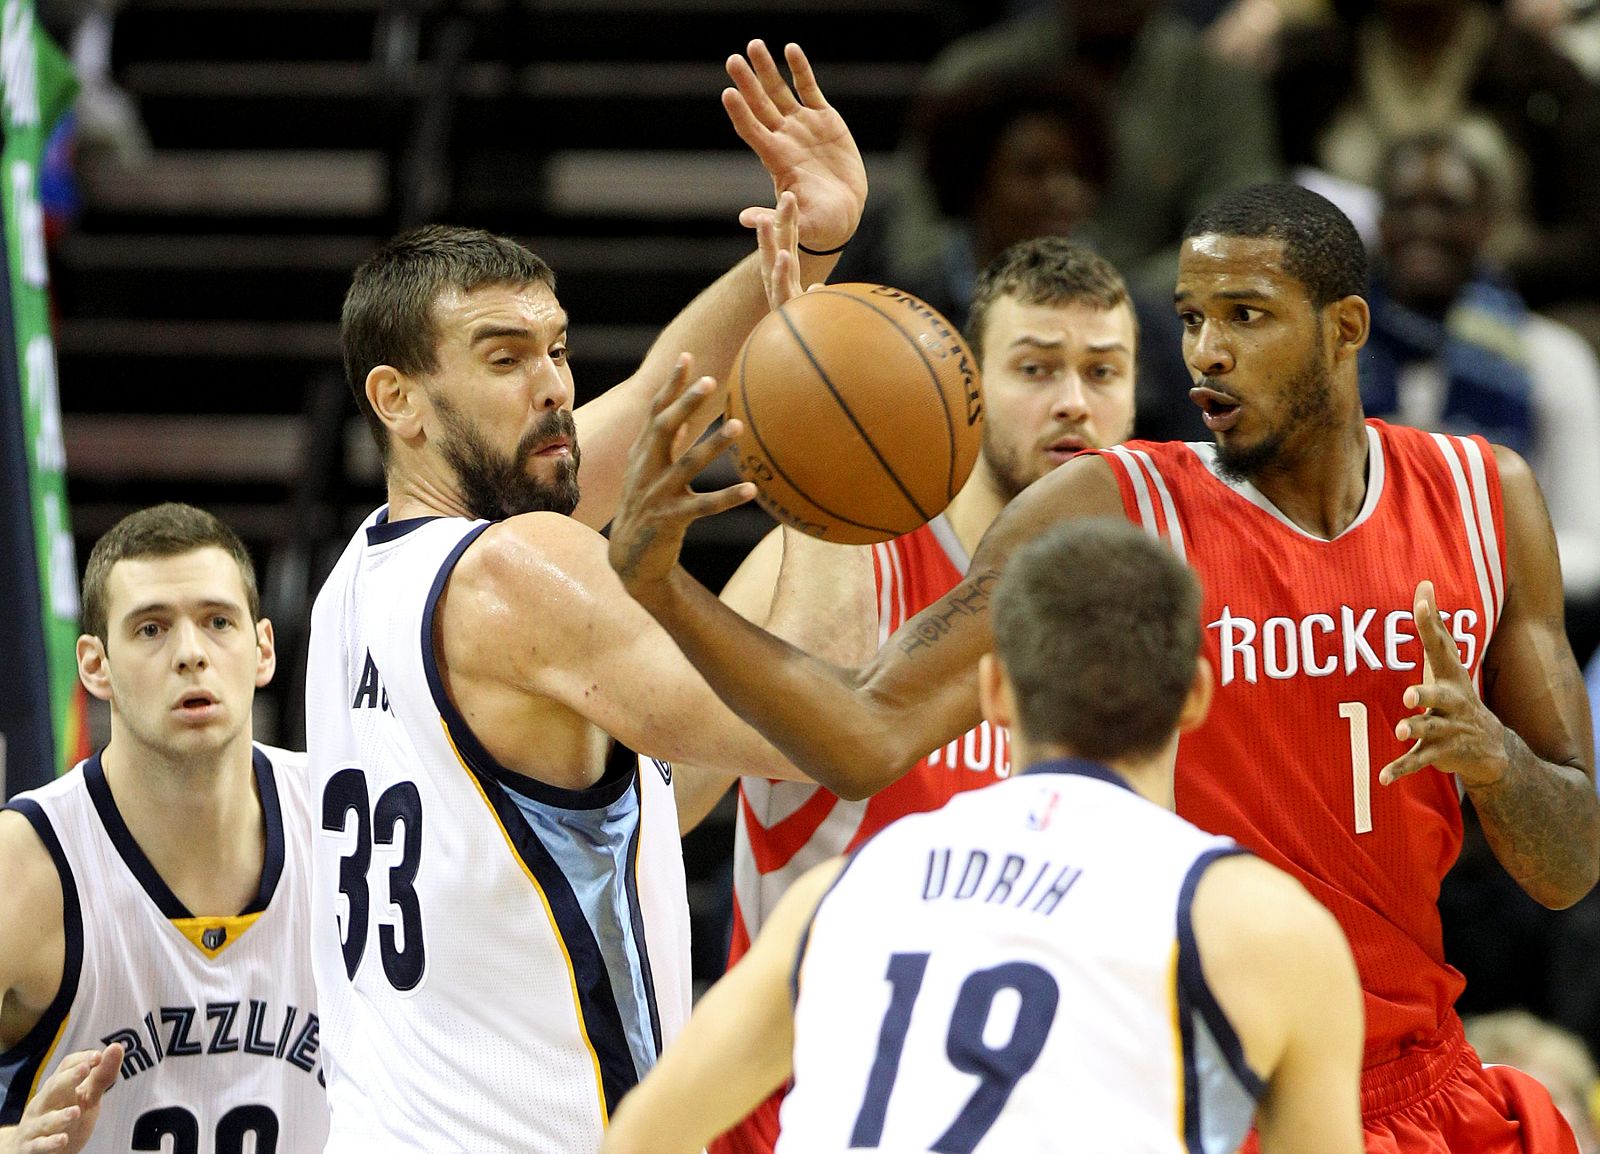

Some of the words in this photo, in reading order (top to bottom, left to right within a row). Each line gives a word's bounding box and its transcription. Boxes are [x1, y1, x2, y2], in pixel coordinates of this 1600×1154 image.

[1206, 604, 1478, 687] ROCKES
[1338, 701, 1373, 834] 1
[321, 767, 426, 992] 33
[922, 847, 1084, 916] UDRIH
[100, 1000, 327, 1094] RIZZLIE
[848, 951, 1060, 1154] 19
